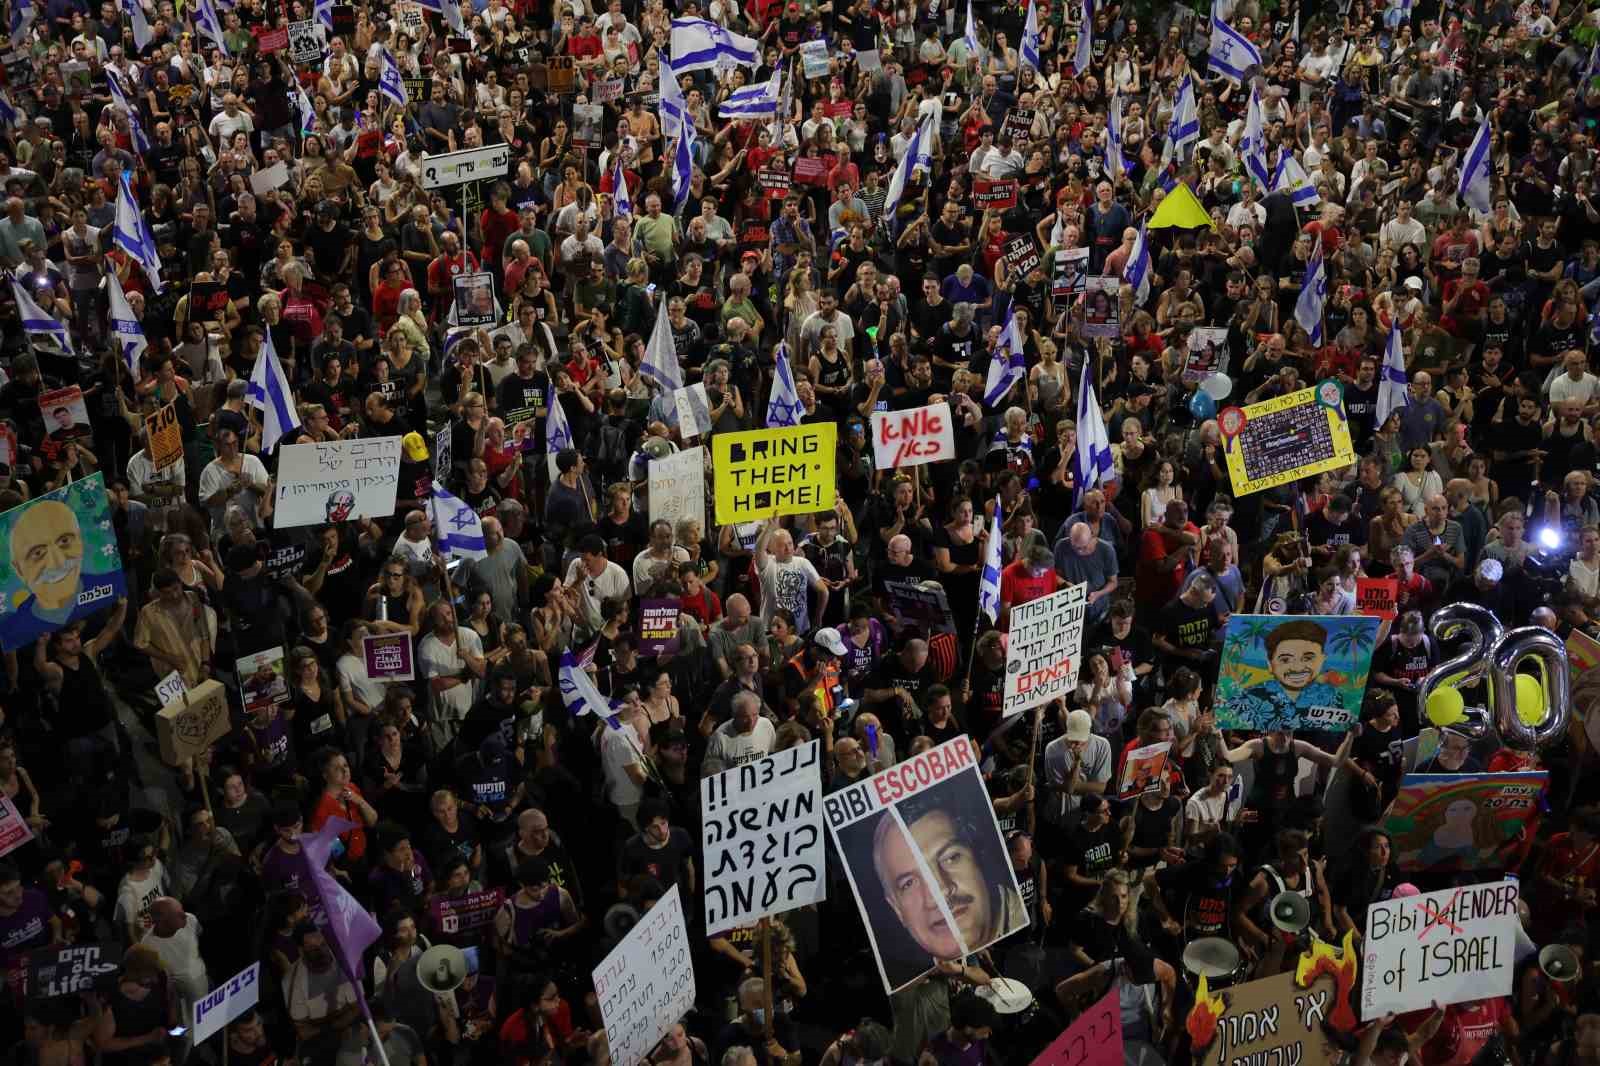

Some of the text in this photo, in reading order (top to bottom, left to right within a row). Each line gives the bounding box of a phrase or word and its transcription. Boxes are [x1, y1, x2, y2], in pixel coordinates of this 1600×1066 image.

[492, 151, 507, 169] למה
[730, 435, 817, 463] BRING
[730, 463, 806, 486] THEM
[734, 484, 820, 512] HOME!
[79, 585, 112, 602] שלמה
[1012, 587, 1083, 627] ביבי הפחדן
[1052, 605, 1082, 630] שכח
[1016, 639, 1045, 658] יהודי
[1017, 658, 1070, 693] האדם
[1418, 601, 1571, 747] 20
[1311, 708, 1348, 722] הירש
[824, 738, 972, 827] BIBI ESCOBAR
[705, 790, 813, 846] ממשלה
[711, 824, 818, 879] בוגדת
[705, 863, 817, 924] בעמה
[1371, 902, 1417, 941] Bibi
[650, 924, 680, 965] 1500
[1383, 948, 1406, 993] of
[1418, 935, 1503, 983] ISRAEL
[48, 974, 94, 997] Life
[1062, 1011, 1117, 1066] ביבי
[1218, 991, 1327, 1063] אי אמון
